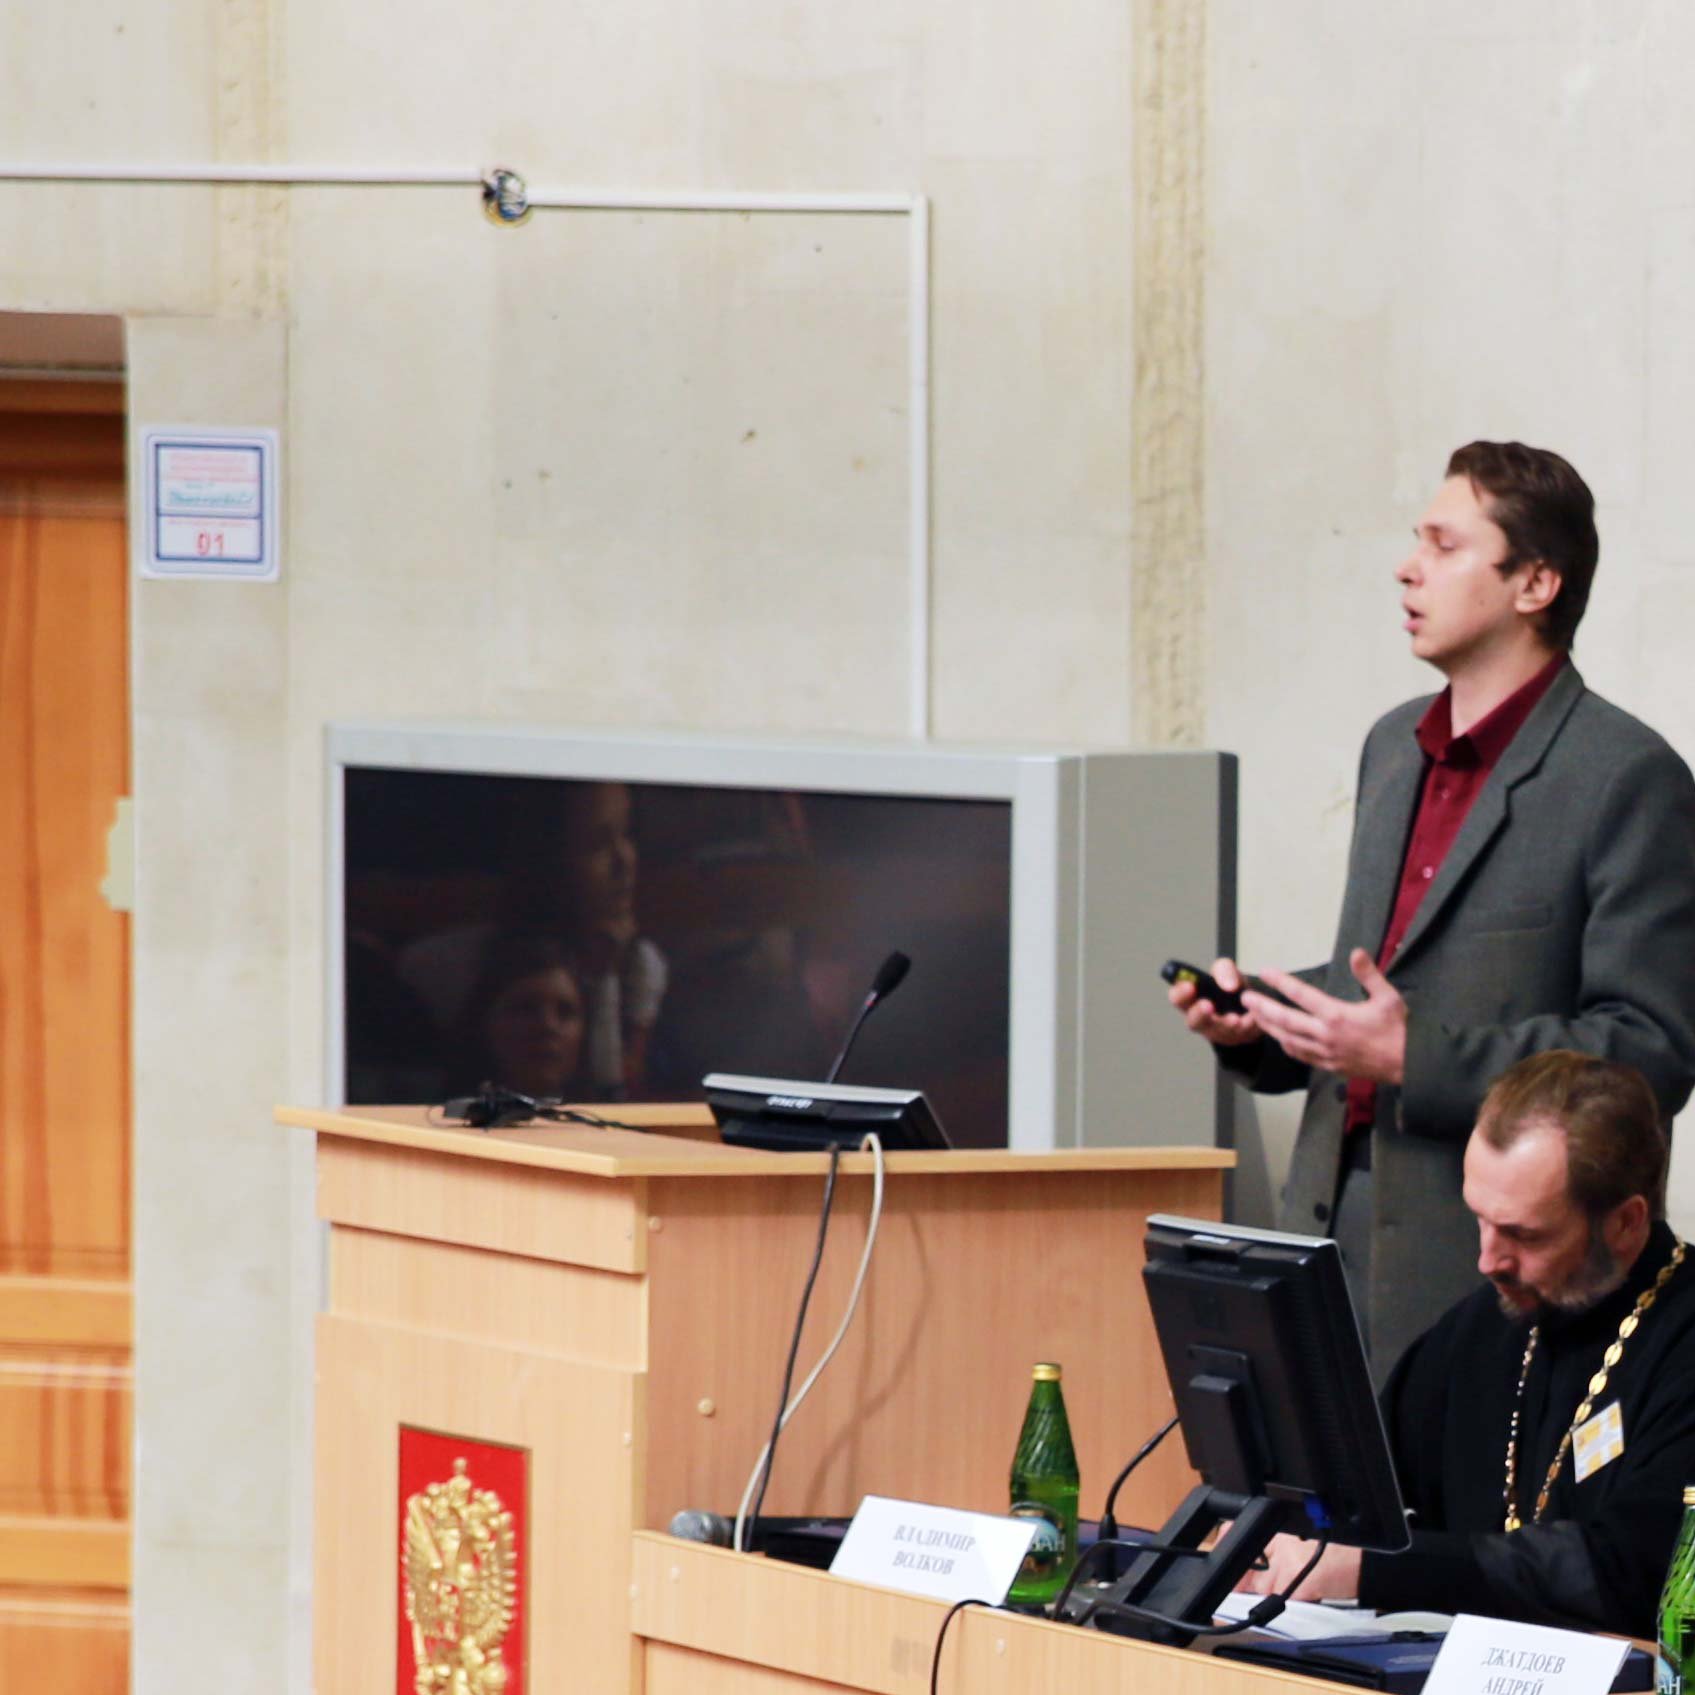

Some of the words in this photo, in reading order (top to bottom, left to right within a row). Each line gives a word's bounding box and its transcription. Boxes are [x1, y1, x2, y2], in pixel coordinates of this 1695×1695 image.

[893, 1524, 977, 1552] ВЛАДИМИР
[892, 1550, 955, 1575] ВОЛКОВ
[1481, 1647, 1567, 1675] ДЖАТДОЕВ
